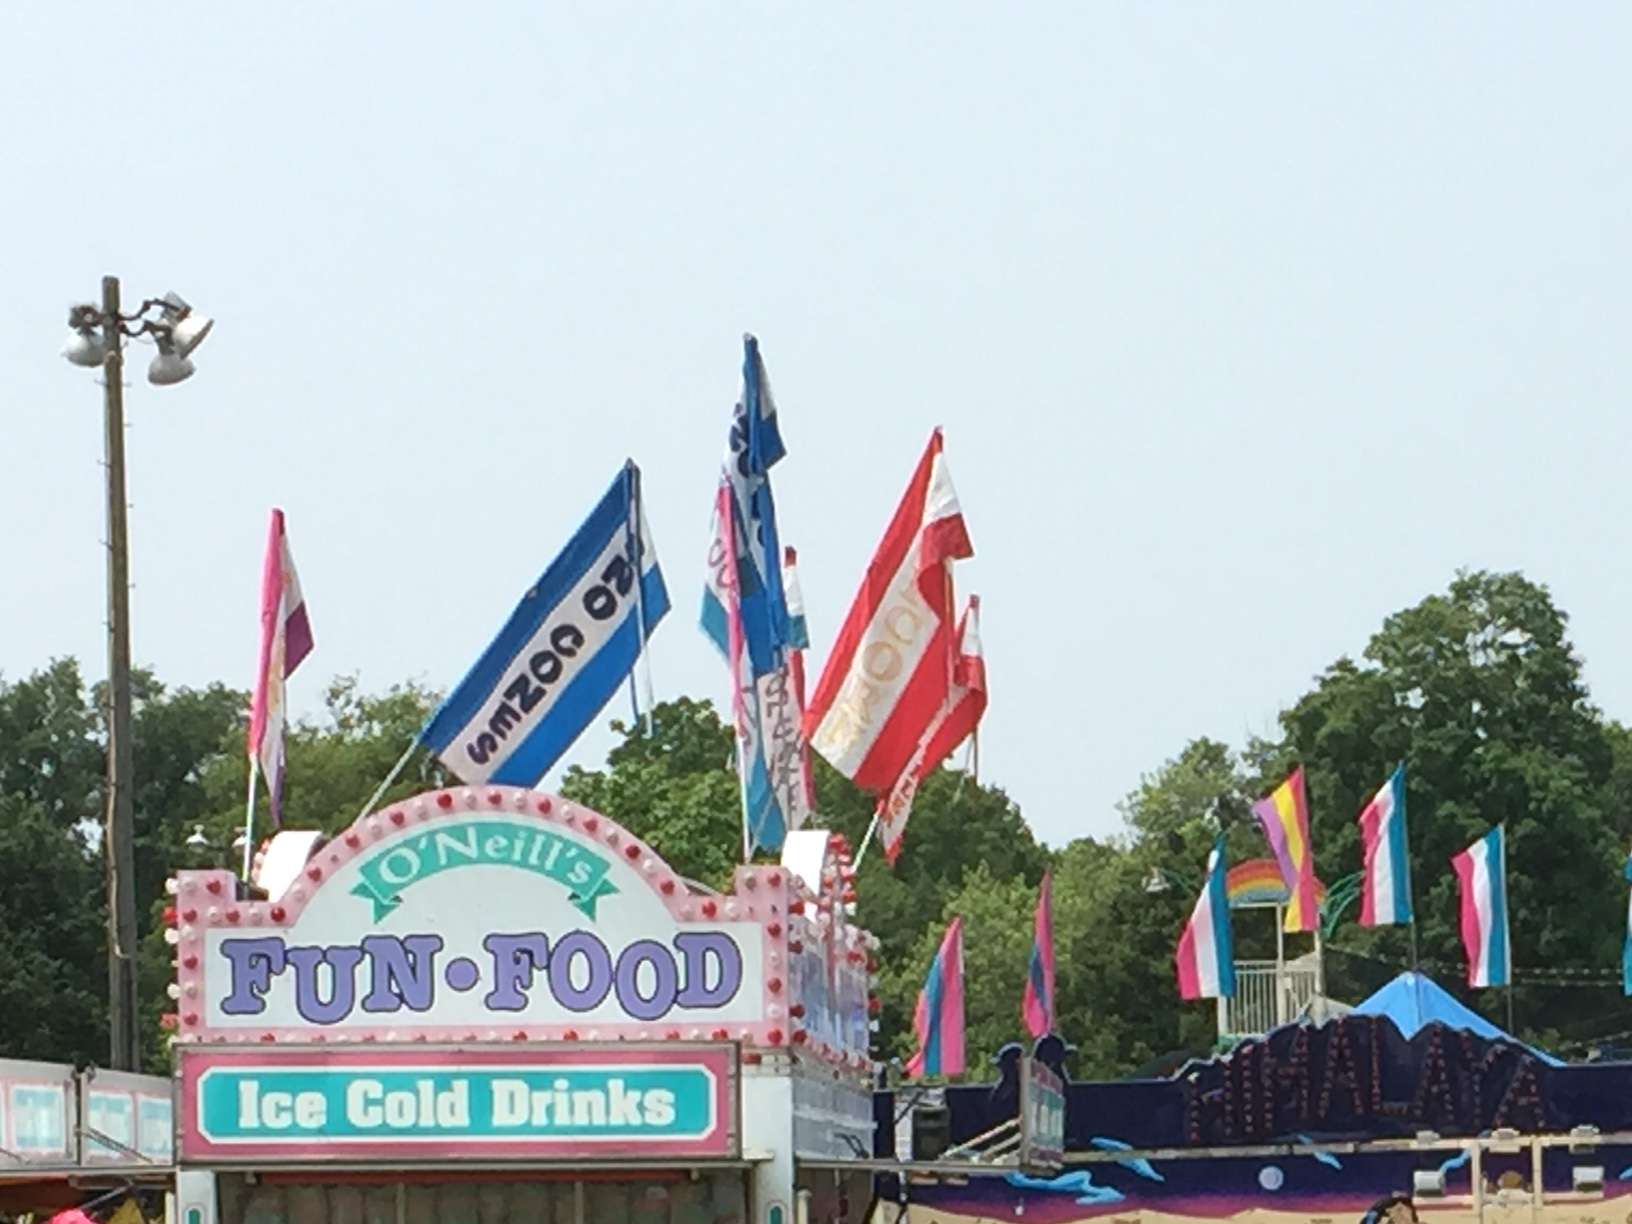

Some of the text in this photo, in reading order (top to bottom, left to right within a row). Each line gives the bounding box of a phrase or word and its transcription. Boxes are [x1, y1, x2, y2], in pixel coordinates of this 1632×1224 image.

[378, 822, 595, 887] O'Neill's
[219, 929, 743, 1025] FUN FOOD
[237, 1077, 676, 1130] Ice Cold Drinks
